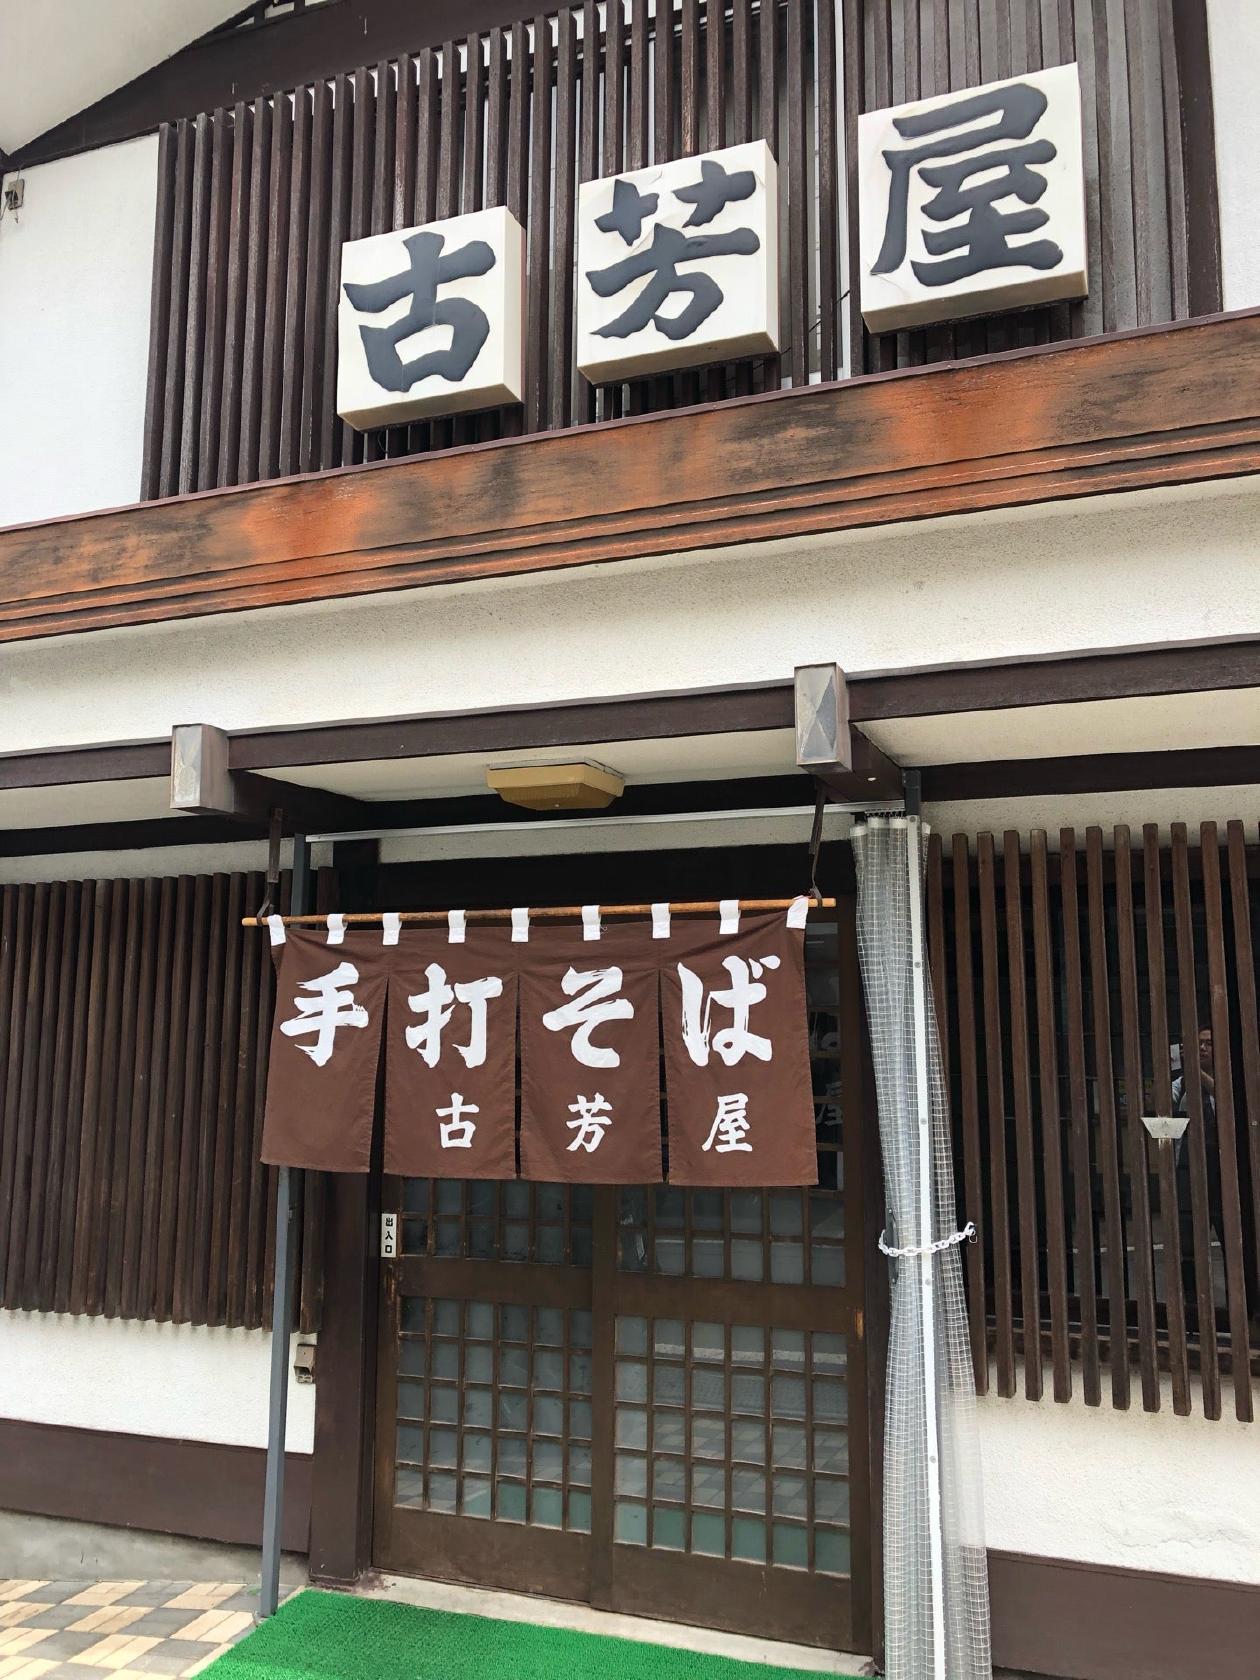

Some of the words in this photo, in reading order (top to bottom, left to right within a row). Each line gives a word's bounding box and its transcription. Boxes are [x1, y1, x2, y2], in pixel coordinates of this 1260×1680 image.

[342, 82, 1064, 393] 古芳屋
[279, 955, 781, 1068] 手打そば
[435, 1092, 753, 1152] 古芳屋
[384, 1217, 394, 1254] 出入口
